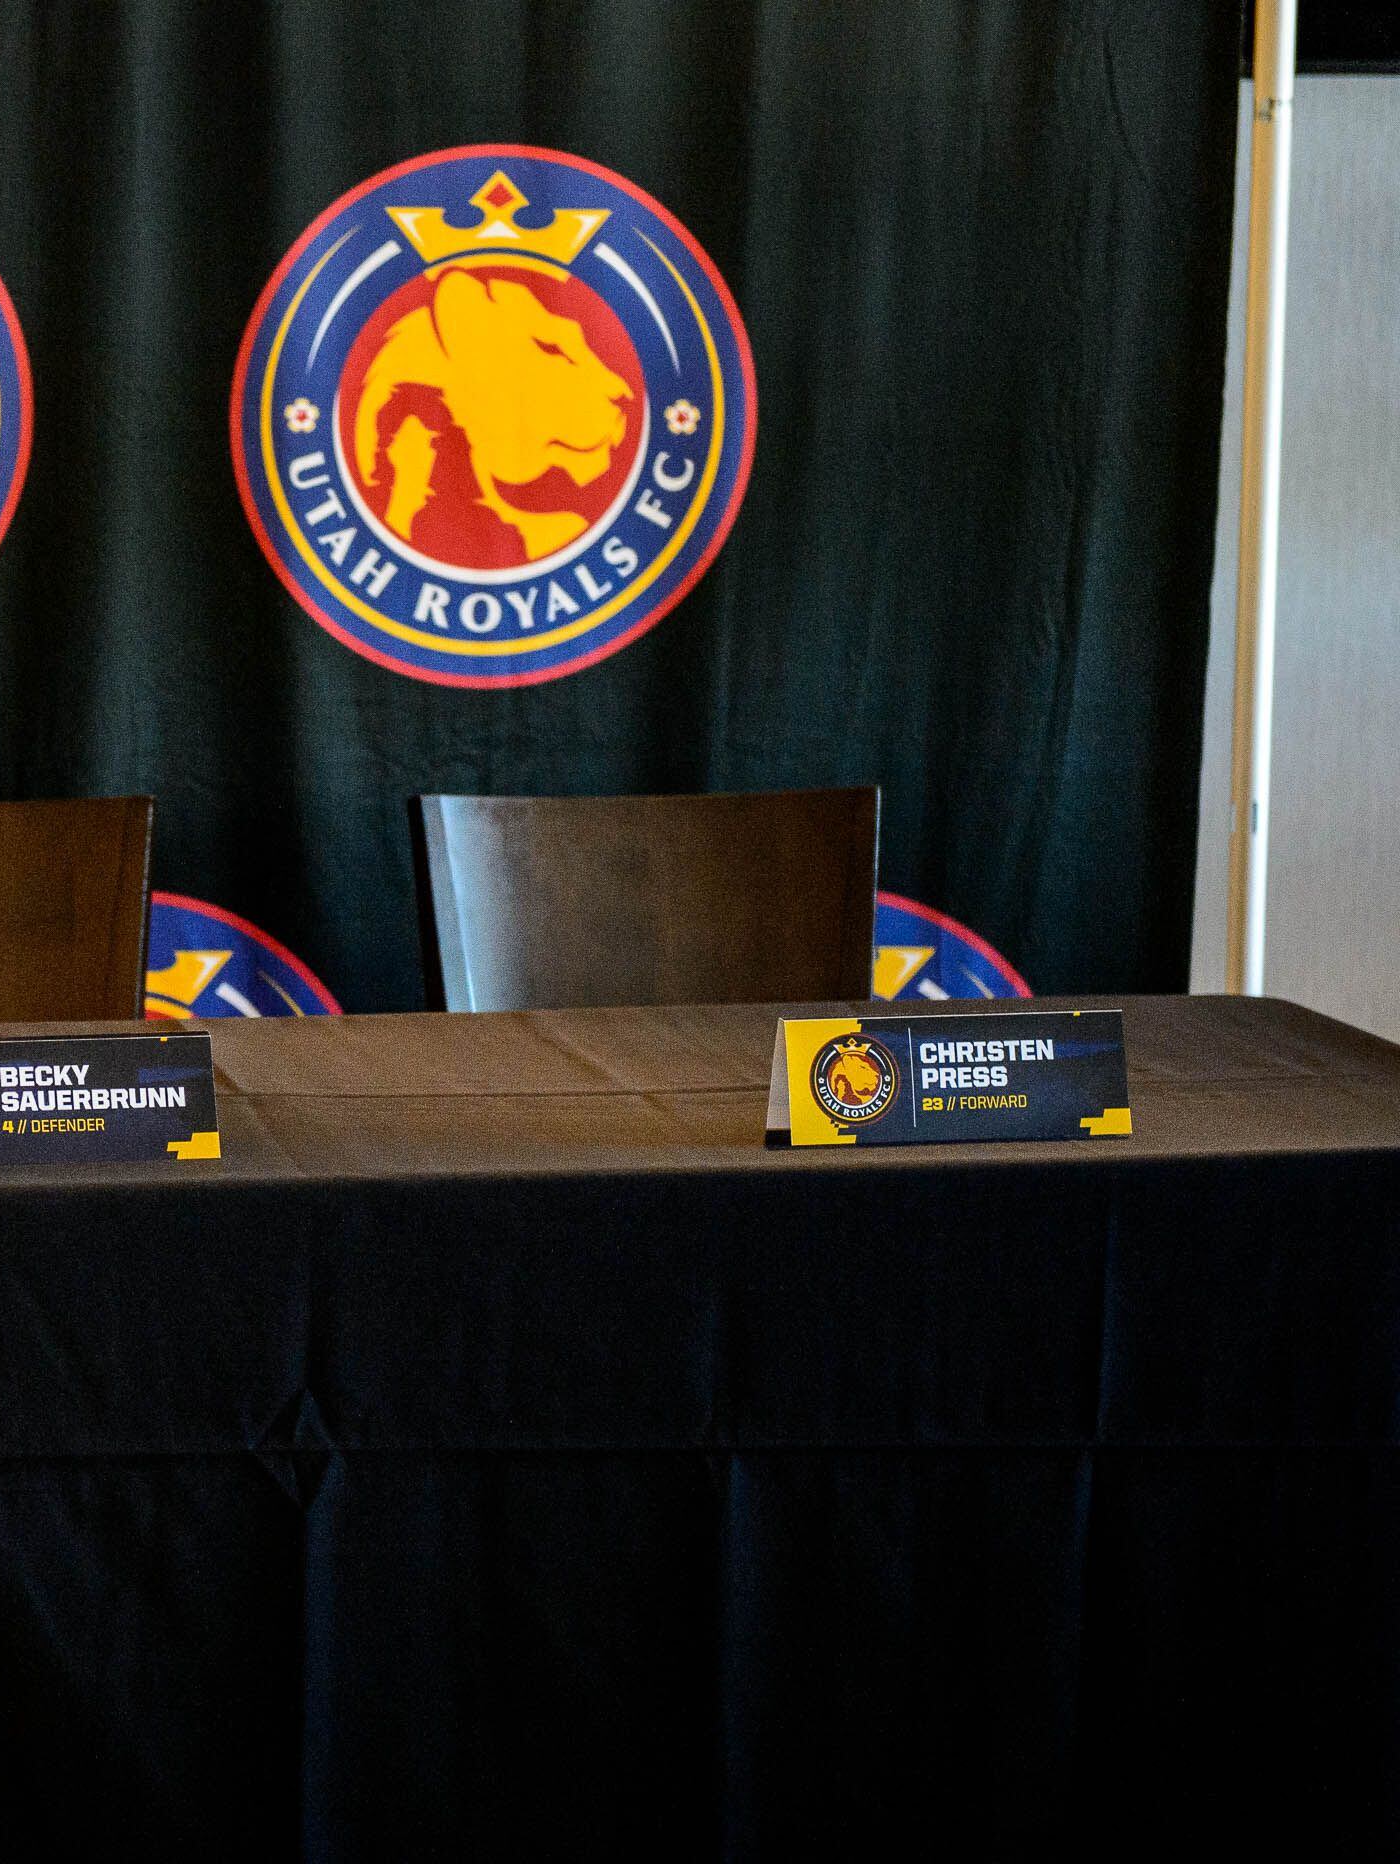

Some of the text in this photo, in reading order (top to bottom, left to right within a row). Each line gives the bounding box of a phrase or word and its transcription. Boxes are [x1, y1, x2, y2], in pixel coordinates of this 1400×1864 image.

[288, 451, 695, 634] UTAH ROYALS FC
[919, 1039, 1054, 1064] CHRISTEN
[0, 1064, 89, 1087] BECKY
[922, 1066, 1008, 1090] PRESS
[1, 1086, 186, 1112] SAUERBRUNN
[819, 1085, 891, 1118] UTAH ROYALS FC
[922, 1097, 943, 1111] 23
[960, 1094, 1027, 1110] FORWARD
[2, 1120, 14, 1133] 4
[31, 1118, 105, 1133] DEFENDER
